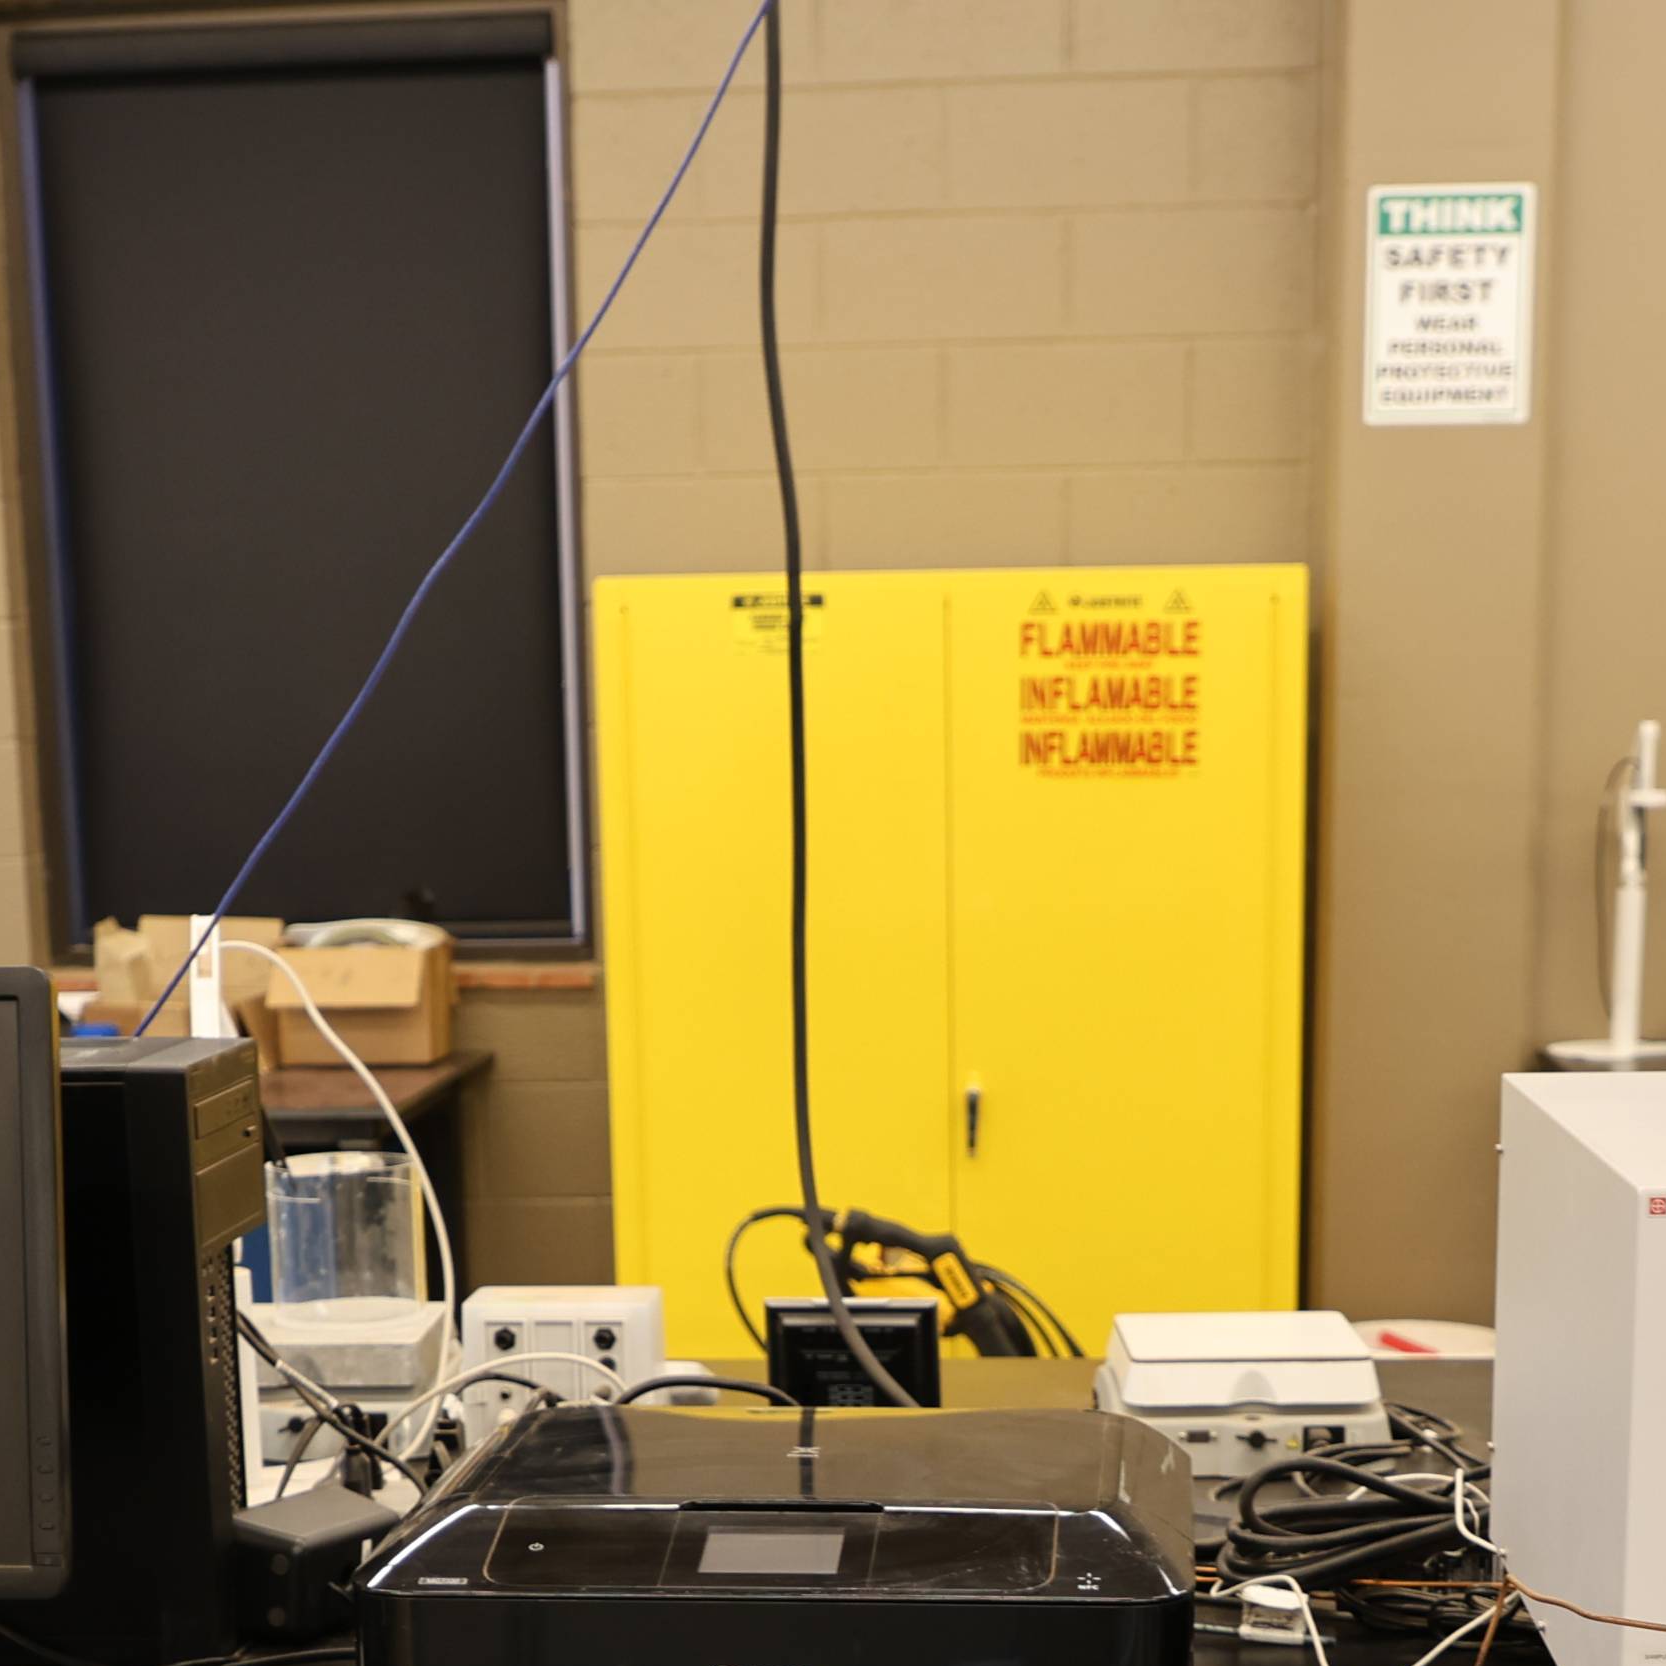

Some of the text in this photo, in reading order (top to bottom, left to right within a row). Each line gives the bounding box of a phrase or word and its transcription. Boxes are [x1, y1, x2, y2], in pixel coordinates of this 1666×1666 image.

[1382, 197, 1520, 234] THINK
[1385, 244, 1510, 269] SAFETY
[1400, 277, 1495, 303] FIRST
[1020, 620, 1201, 657] FLAMMABLE
[1020, 675, 1199, 711] INFLAMABLE
[1020, 730, 1199, 765] INFLAMMABLE
